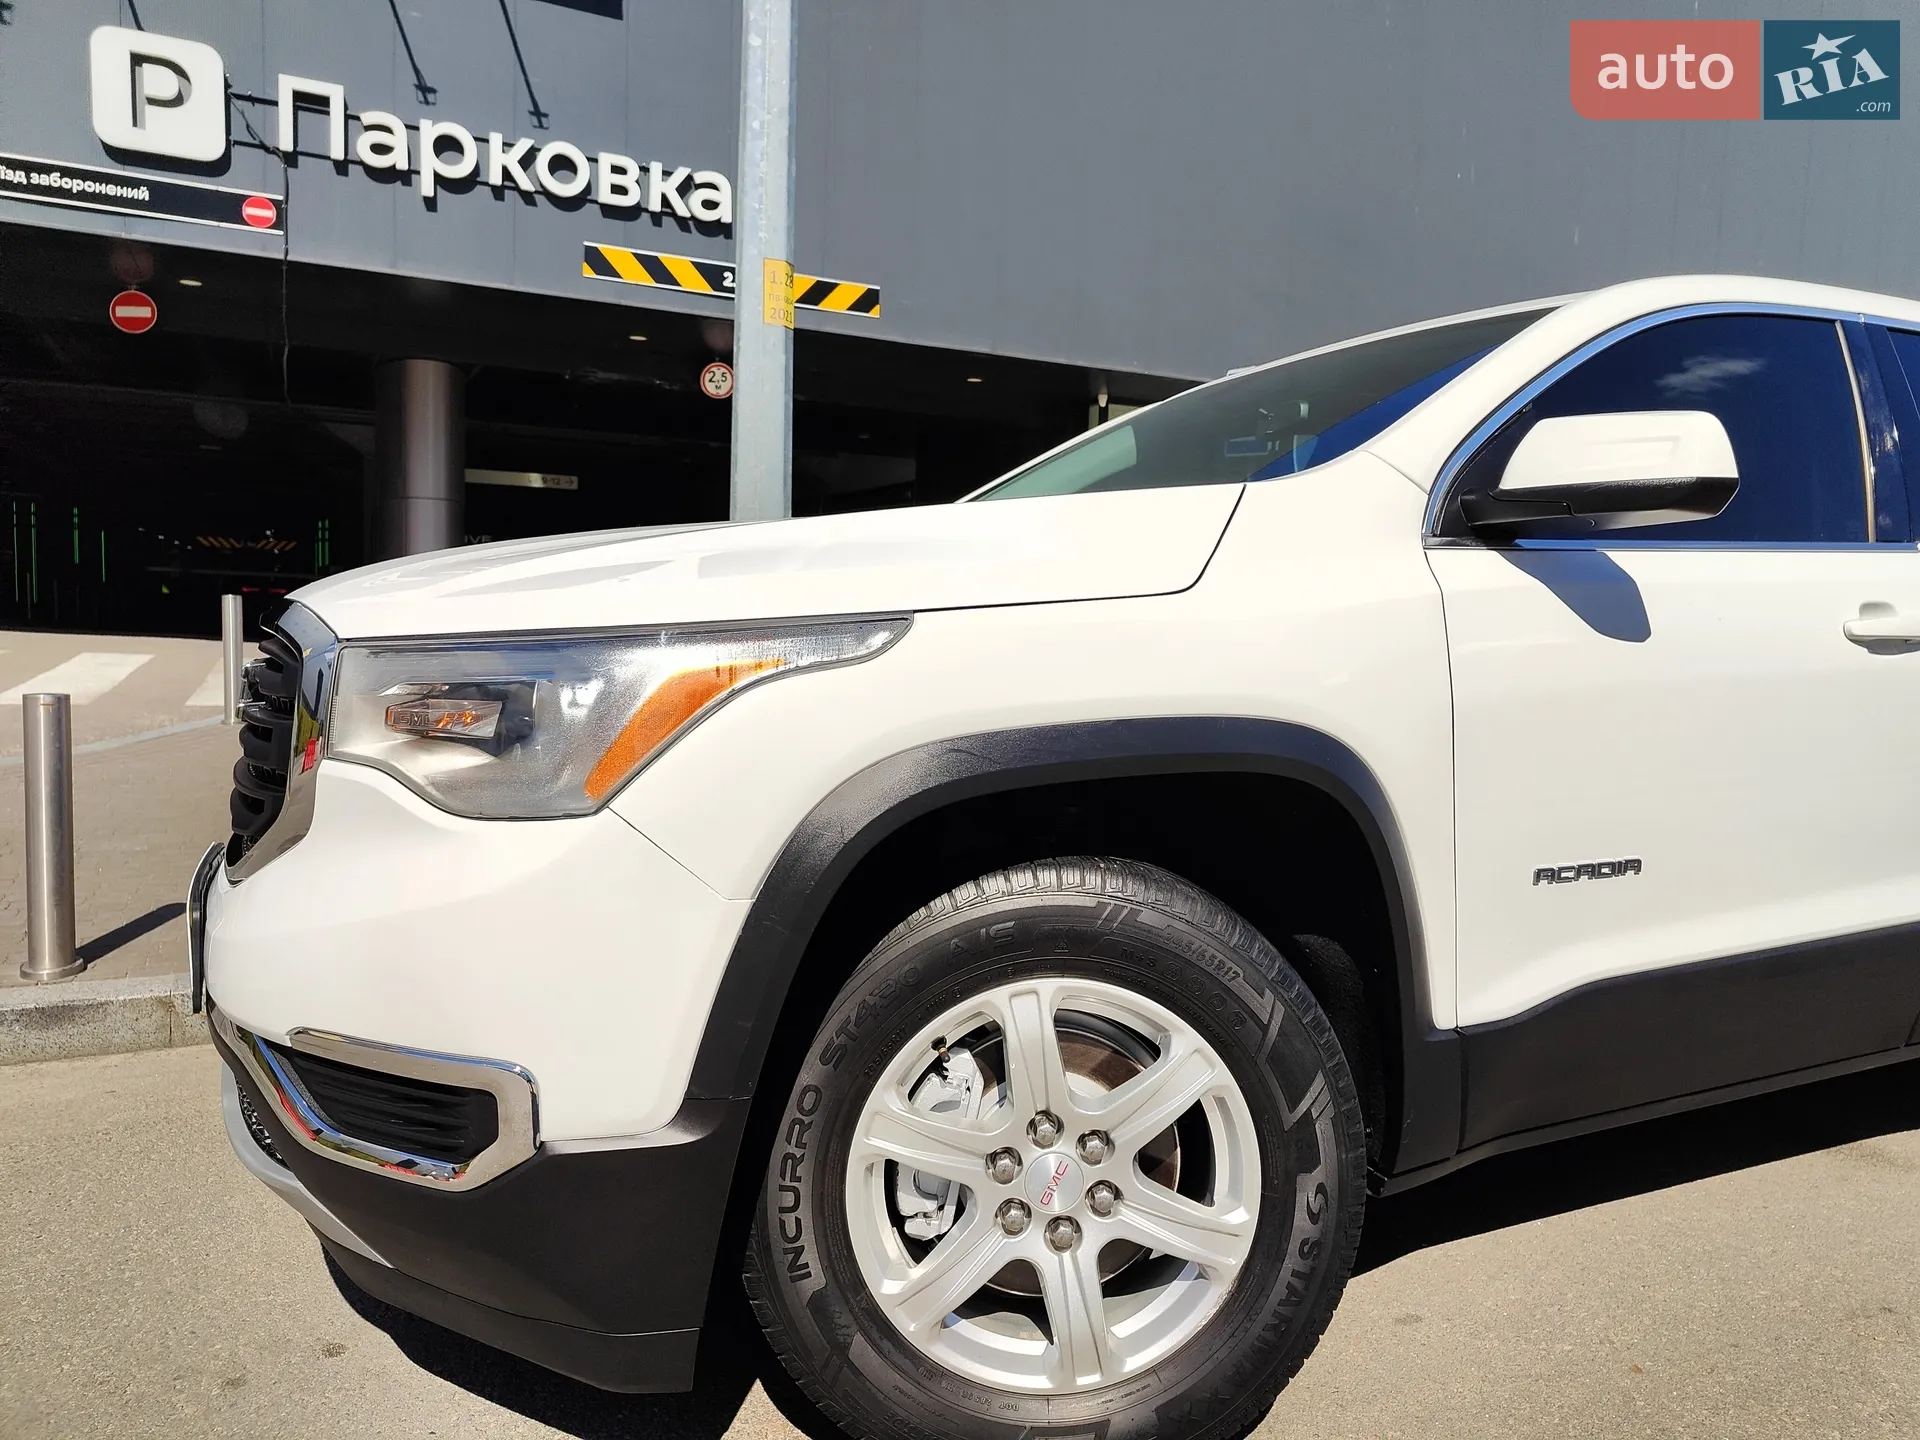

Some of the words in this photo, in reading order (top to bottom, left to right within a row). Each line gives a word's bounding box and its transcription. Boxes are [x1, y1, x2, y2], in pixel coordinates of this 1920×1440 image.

[130, 50, 193, 130] P
[277, 73, 734, 225] Парковка
[30, 172, 150, 202] заборонений
[1532, 858, 1642, 886] ACADIA
[1163, 932, 1241, 983] 245/65R17
[778, 1083, 823, 1283] INCURRO
[818, 965, 923, 1071] ST430
[1040, 1160, 1069, 1206] GMC
